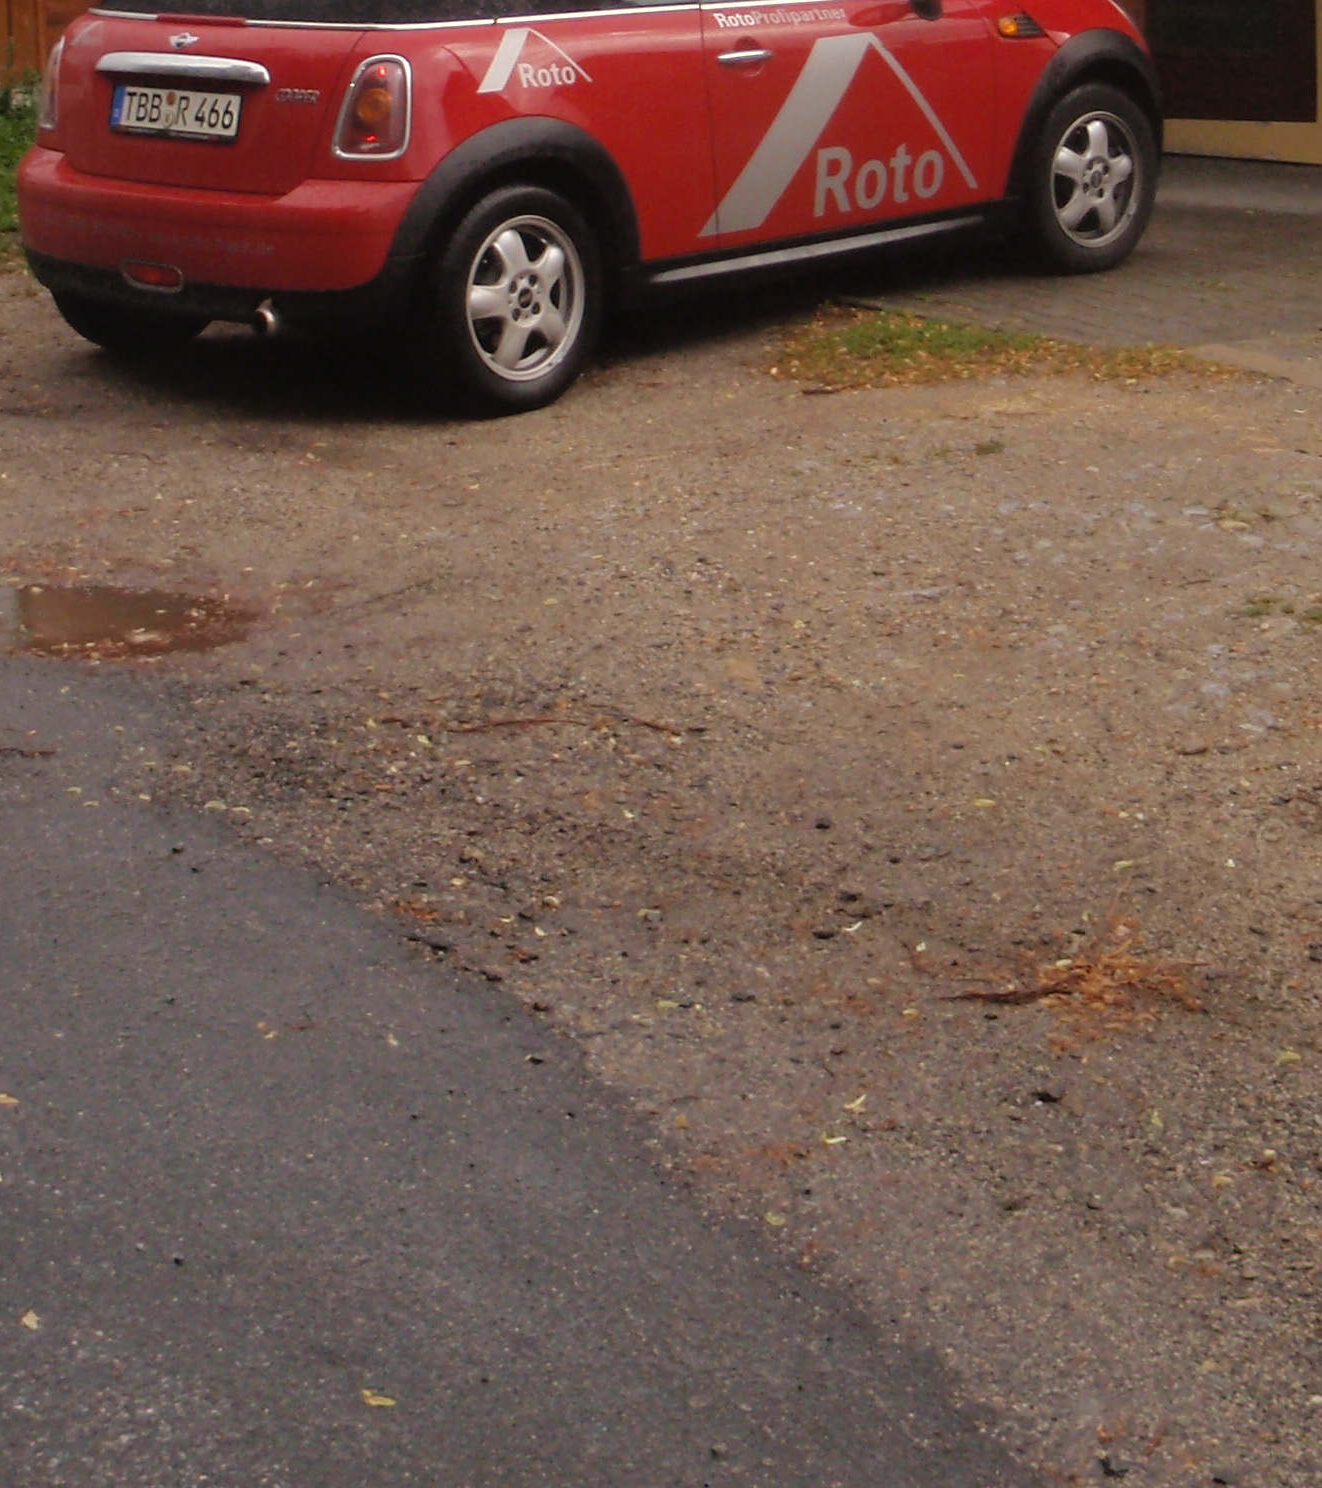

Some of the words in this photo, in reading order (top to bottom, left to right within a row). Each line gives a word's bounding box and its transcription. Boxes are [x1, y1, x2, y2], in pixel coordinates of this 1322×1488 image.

[518, 62, 577, 89] Roto
[126, 91, 163, 123] TBB
[176, 95, 191, 127] R
[194, 97, 235, 130] 466
[813, 141, 944, 218] Roto
